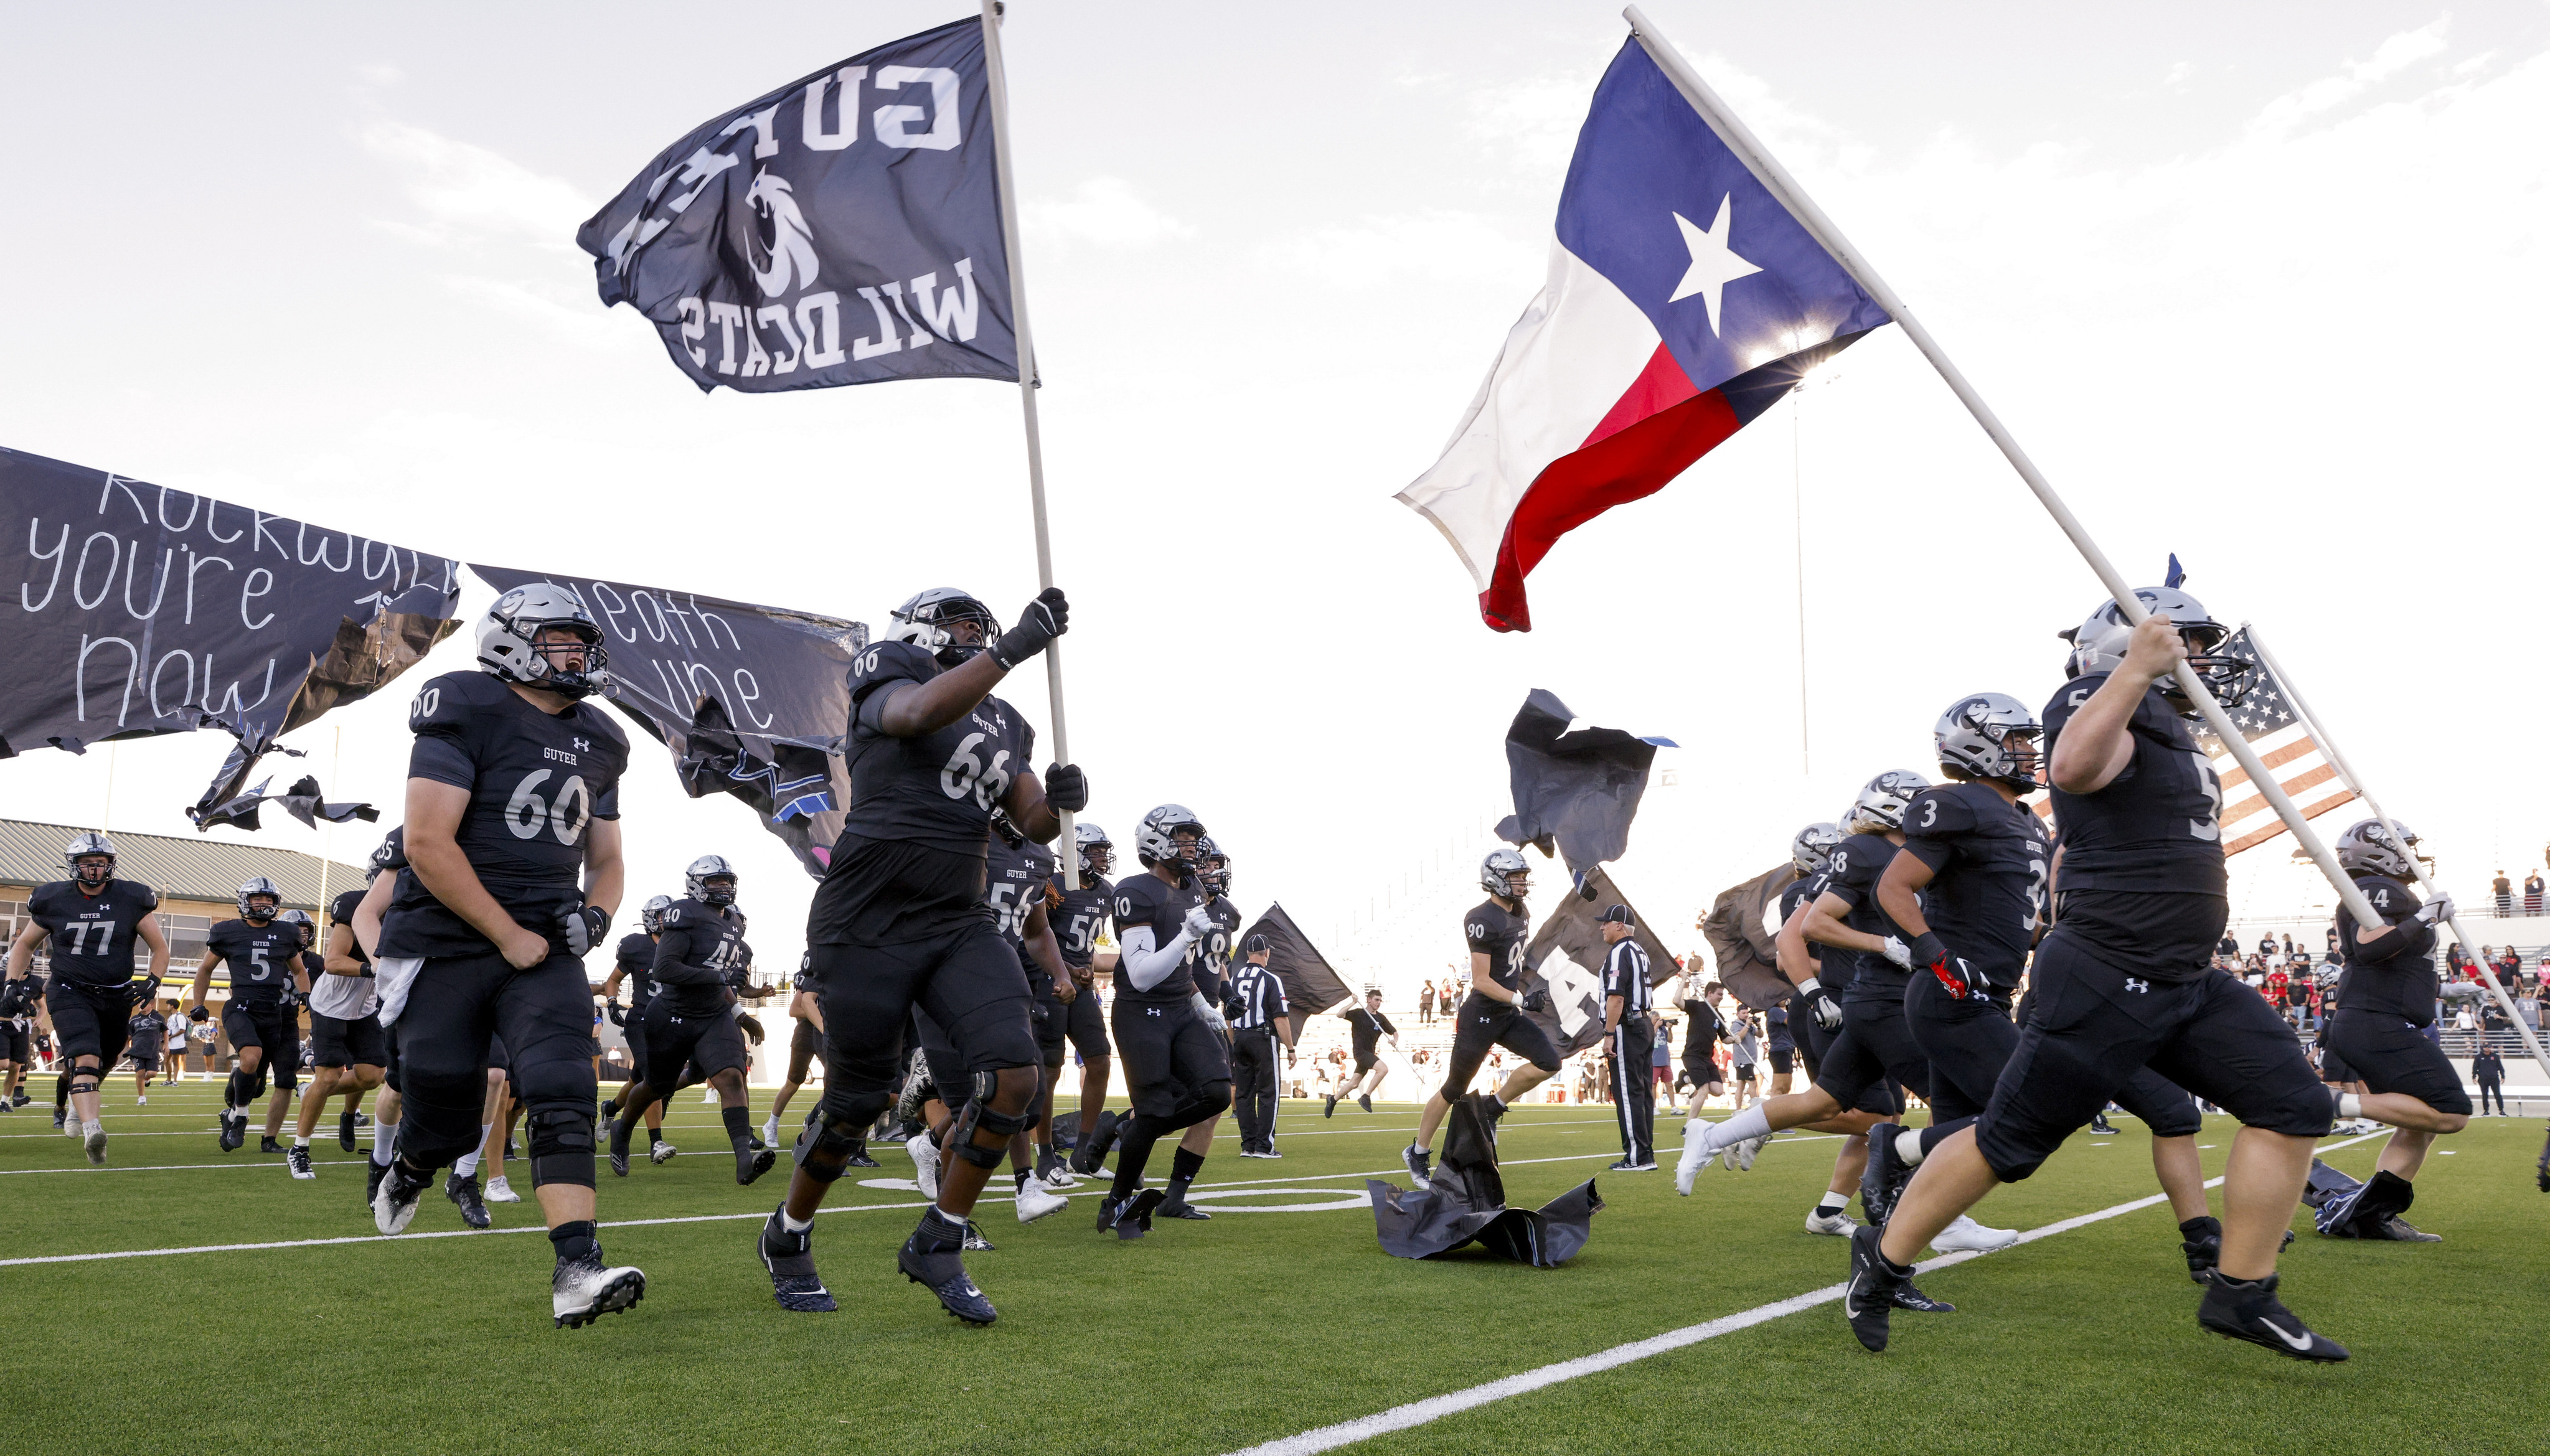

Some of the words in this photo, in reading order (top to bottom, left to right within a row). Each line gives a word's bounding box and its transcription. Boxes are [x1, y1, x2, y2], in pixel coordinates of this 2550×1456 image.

[21, 517, 275, 630] you're
[854, 647, 882, 678] 66
[77, 633, 276, 728] now
[413, 687, 440, 718] 60
[972, 713, 999, 737] GUYER
[543, 746, 577, 766] GUYER
[940, 732, 1010, 811] 66
[504, 769, 590, 846] 60
[1920, 799, 1937, 827] 3
[1007, 869, 1027, 879] GUYER
[990, 881, 1035, 937] 56
[1114, 896, 1131, 917] 10
[2023, 859, 2047, 931] 3
[664, 908, 680, 923] 40
[1467, 923, 1484, 939] 90
[65, 921, 115, 956] 77
[723, 932, 735, 941] GUYER
[1065, 914, 1103, 953] 50
[250, 948, 270, 981] 5
[1238, 979, 1253, 1007] S
[1860, 1253, 1870, 1269] ALPHA
